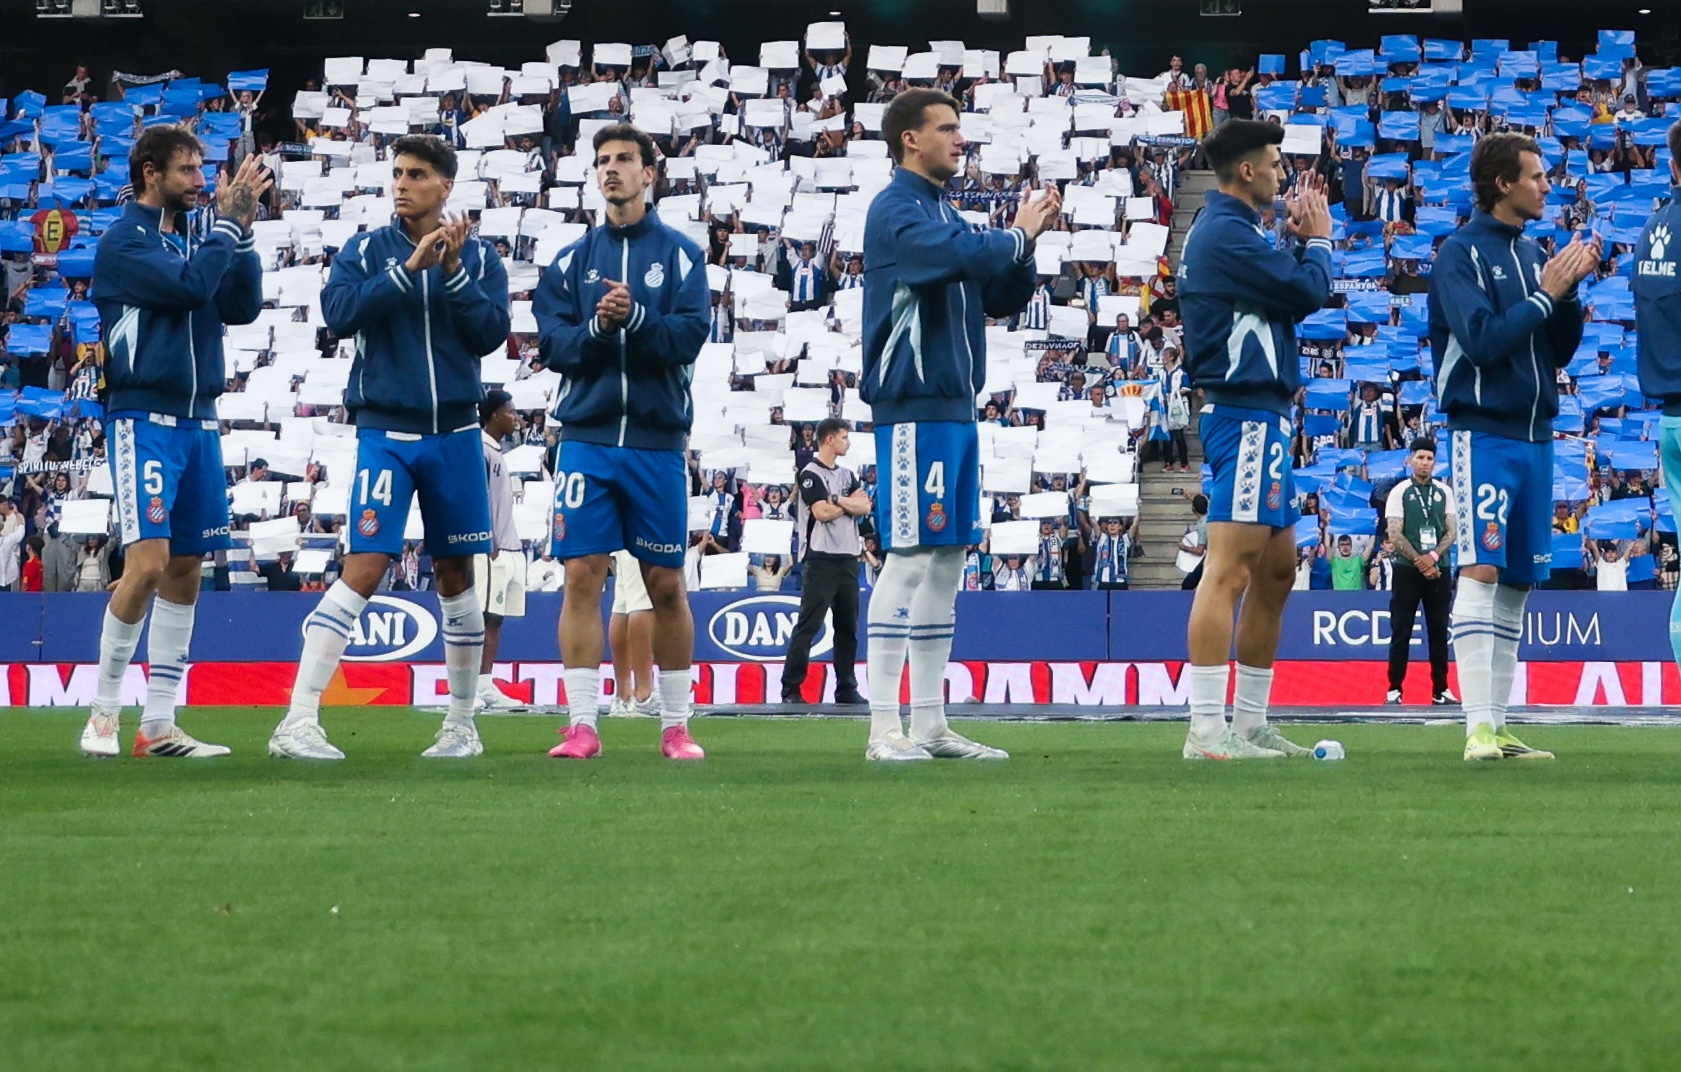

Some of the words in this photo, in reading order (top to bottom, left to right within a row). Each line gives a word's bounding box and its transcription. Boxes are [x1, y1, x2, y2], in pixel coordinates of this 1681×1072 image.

[1269, 442, 1284, 479] 2
[144, 461, 162, 494] 5
[359, 469, 393, 506] 14
[554, 471, 585, 509] 20
[925, 461, 945, 498] 4
[1477, 484, 1509, 526] 22
[203, 525, 230, 538] SKO
[448, 531, 493, 543] SKODA
[636, 536, 683, 553] SKODA
[345, 614, 408, 646] ANI
[725, 613, 796, 646] DAN
